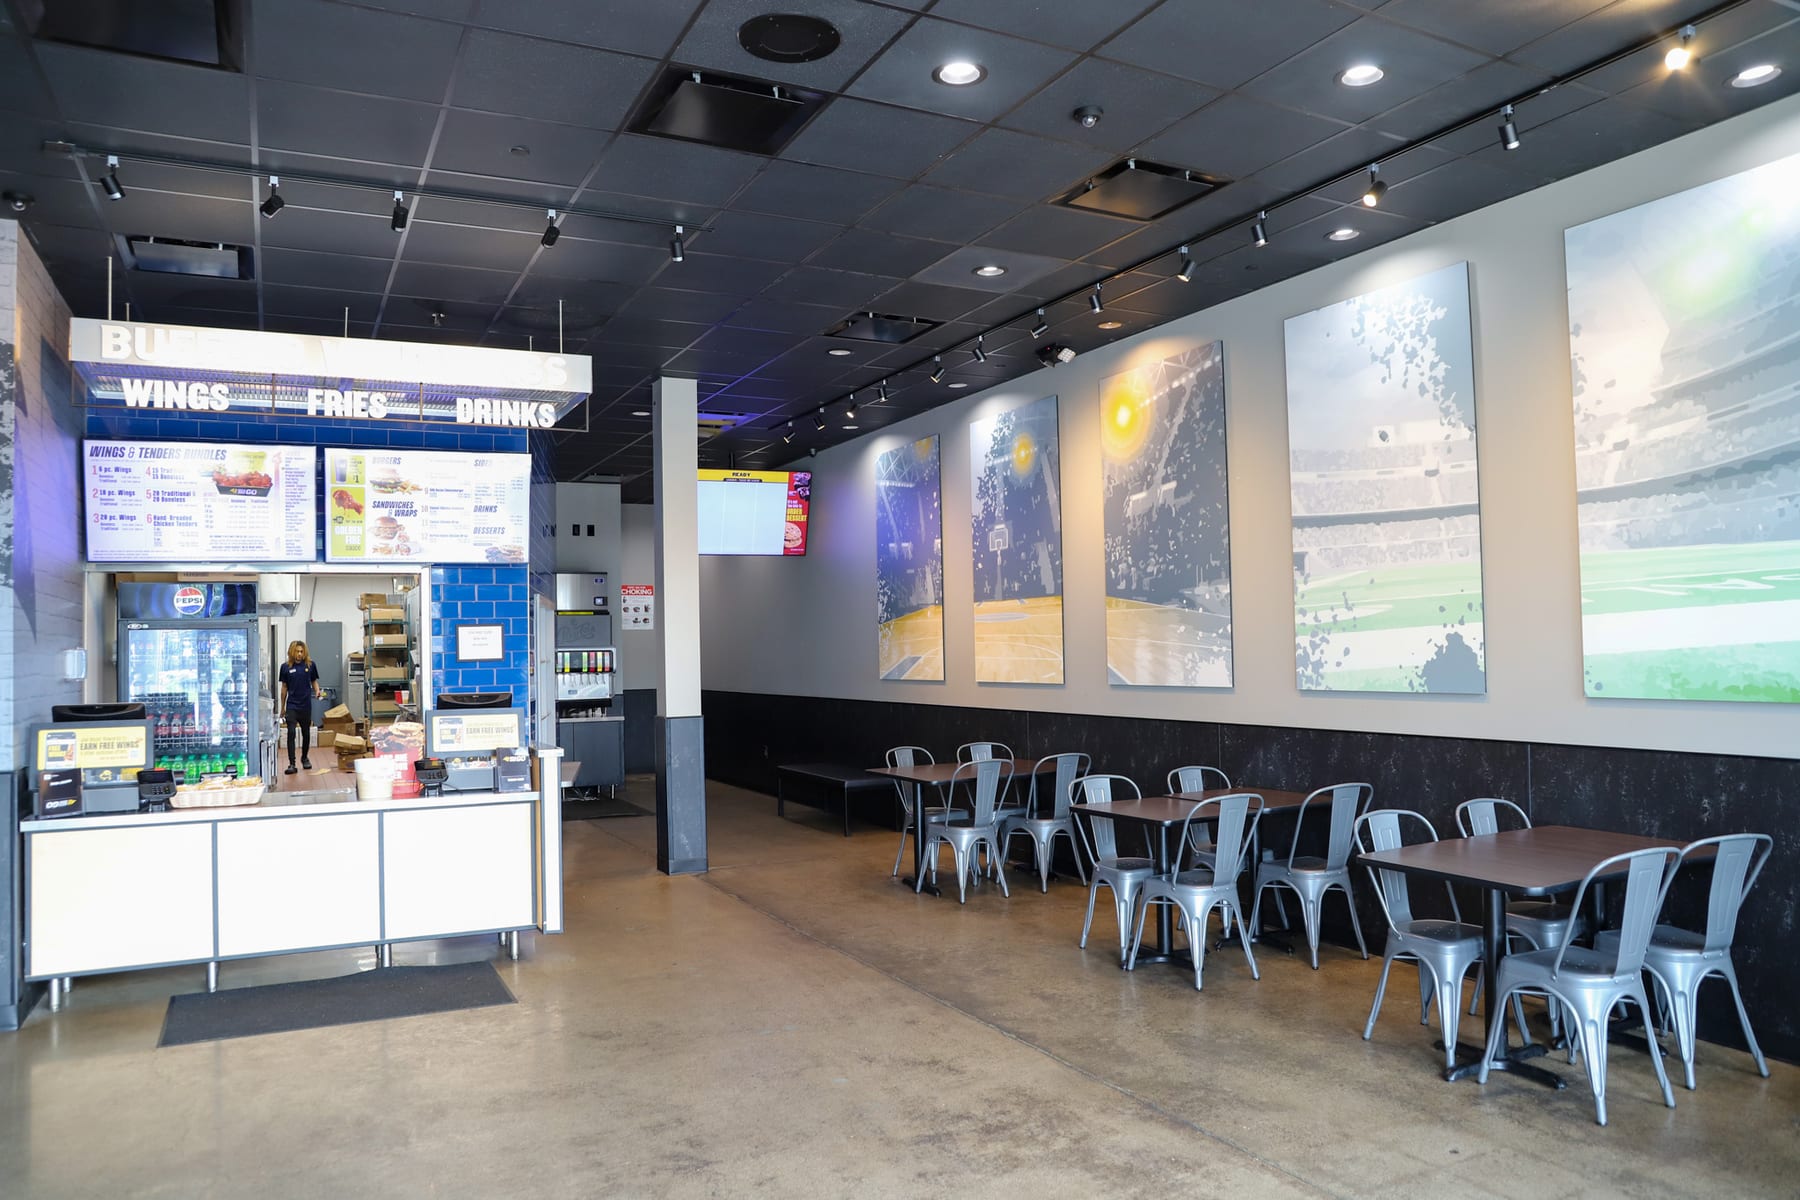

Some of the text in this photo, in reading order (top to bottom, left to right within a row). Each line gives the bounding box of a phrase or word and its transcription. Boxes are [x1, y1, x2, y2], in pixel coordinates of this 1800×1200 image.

[121, 378, 230, 411] WINGS
[307, 388, 387, 419] FRIES
[456, 397, 556, 428] DRINKS
[89, 446, 126, 459] WINGS
[128, 447, 136, 459] &
[138, 447, 182, 460] TENDERS
[92, 464, 98, 476] 1
[114, 466, 132, 474] Wings
[145, 466, 151, 477] 4
[92, 487, 99, 499] 2
[118, 489, 137, 498] Wings
[146, 488, 152, 500] 5
[372, 500, 415, 509] SANDWICHES
[473, 504, 498, 513] DRINKS
[93, 512, 100, 524] 3
[119, 514, 137, 522] Wings
[147, 513, 153, 525] 6
[394, 509, 419, 518] WRAPS
[473, 526, 506, 535] DESSERTS
[466, 726, 514, 735] EARN FREE WINGS
[80, 740, 140, 751] EARN FREE WINGS
